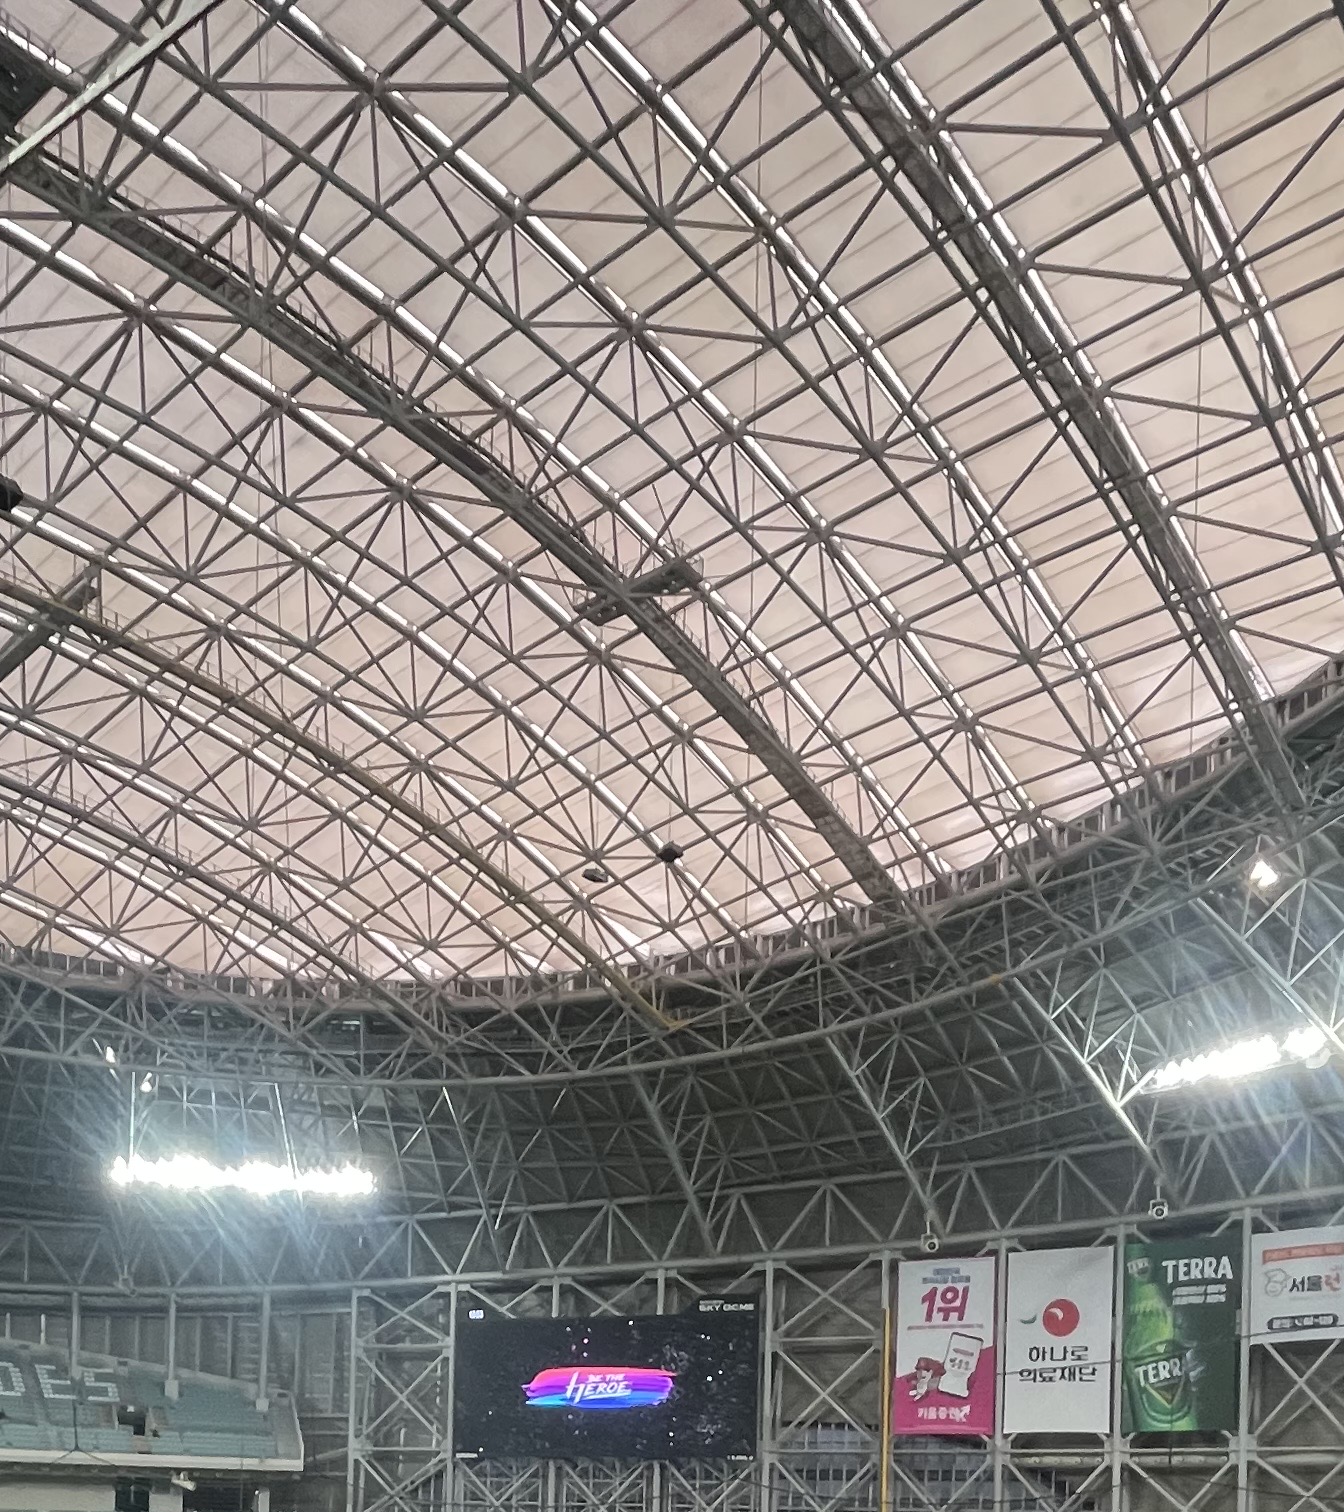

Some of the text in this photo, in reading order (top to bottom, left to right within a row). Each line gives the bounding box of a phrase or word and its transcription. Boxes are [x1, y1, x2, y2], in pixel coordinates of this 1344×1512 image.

[1161, 1256, 1233, 1284] TERRA
[1288, 1272, 1341, 1293] 서울런
[921, 1285, 969, 1322] 1위
[1028, 1345, 1089, 1362] 하나로
[605, 1373, 626, 1382] THE
[1019, 1366, 1097, 1383] 의료재단
